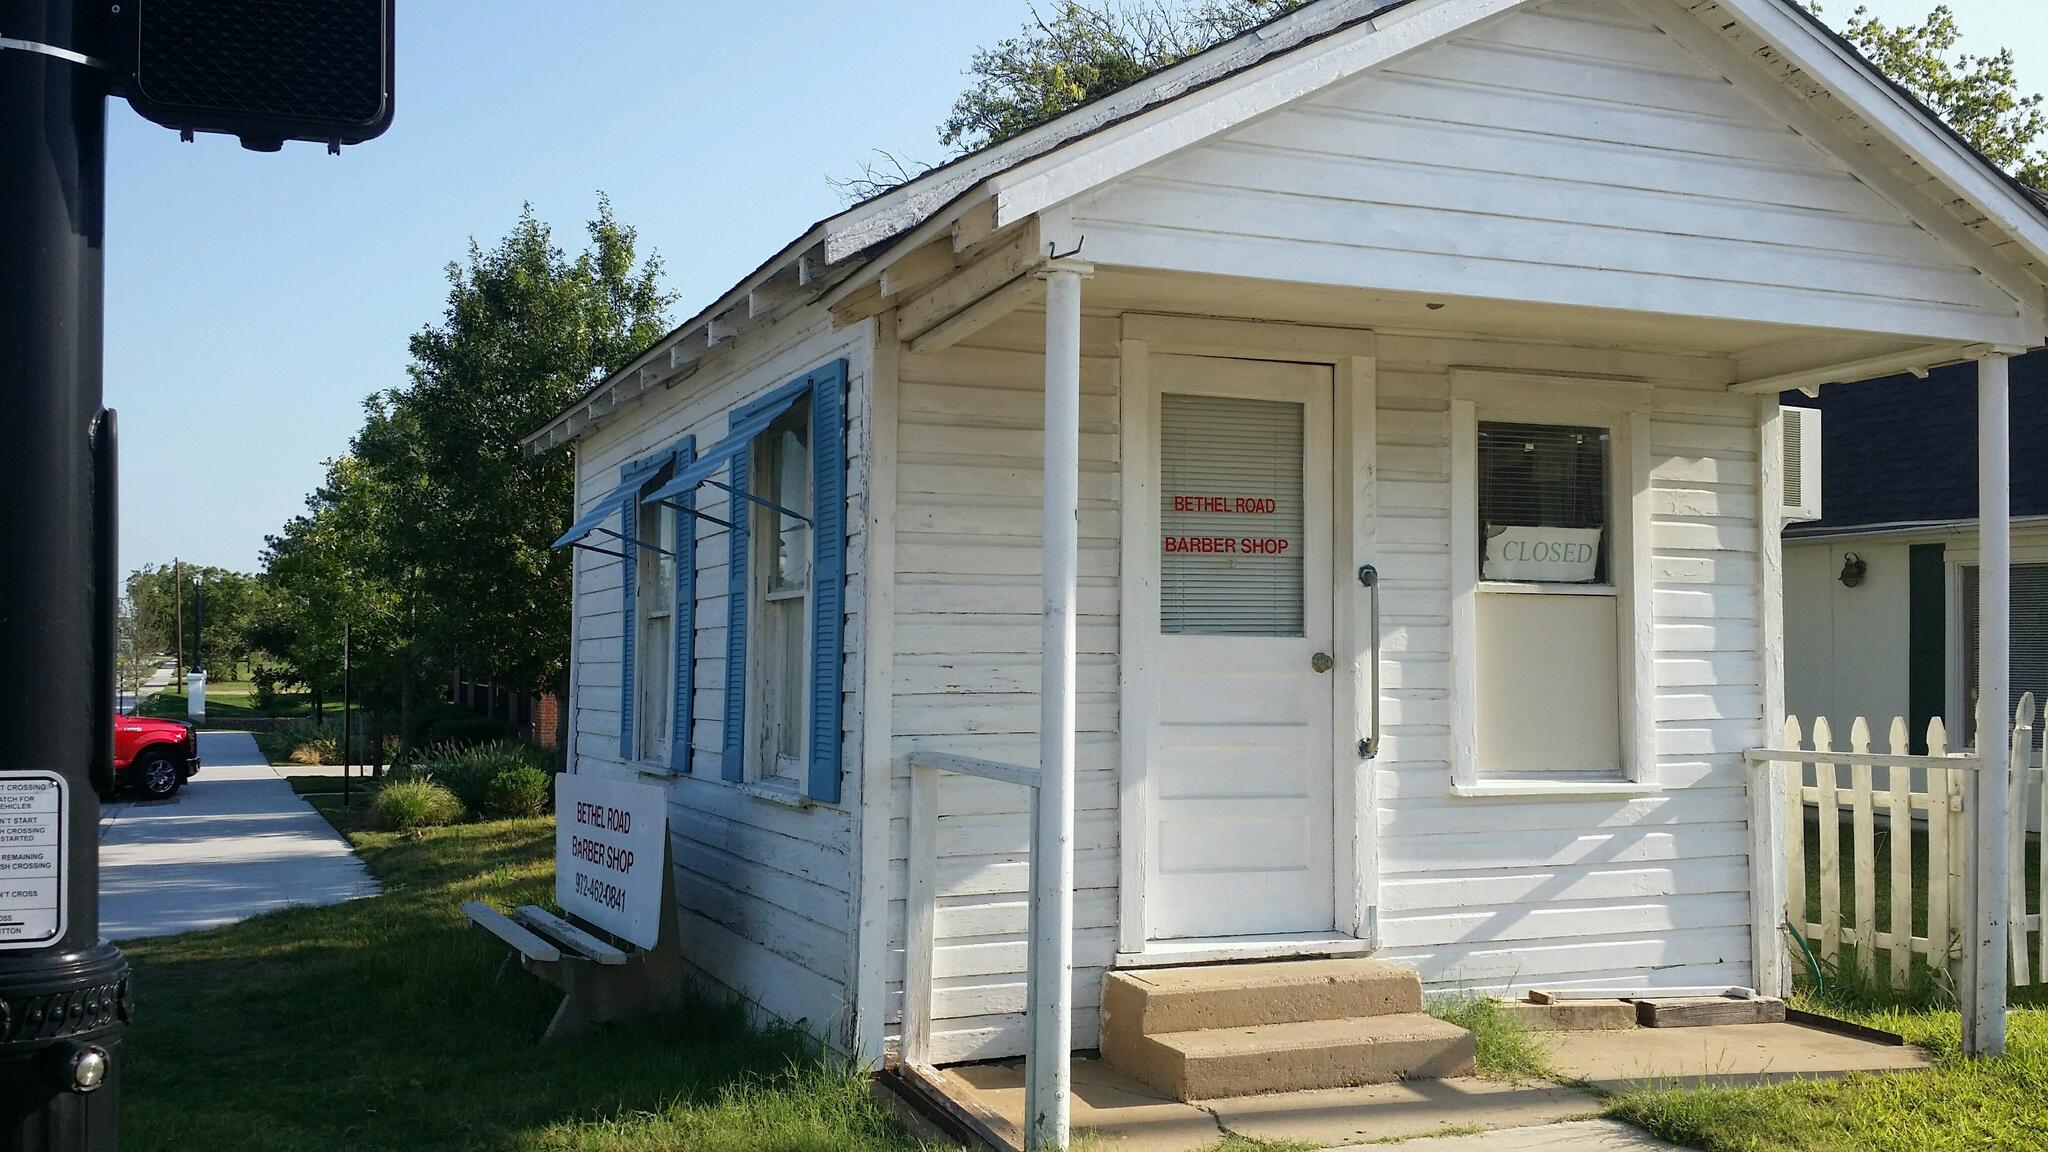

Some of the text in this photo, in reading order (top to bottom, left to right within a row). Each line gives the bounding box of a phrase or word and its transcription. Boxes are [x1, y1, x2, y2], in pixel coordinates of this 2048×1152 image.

[1174, 496, 1276, 513] BETHEL ROAD
[1165, 536, 1289, 554] BARBER SHOP
[1503, 540, 1593, 563] CLOSED
[7, 783, 46, 791] CROSSING
[577, 801, 631, 834] BETHEL ROAD
[572, 835, 634, 874] BARBER SHOP
[575, 872, 626, 913] 972-462-0841
